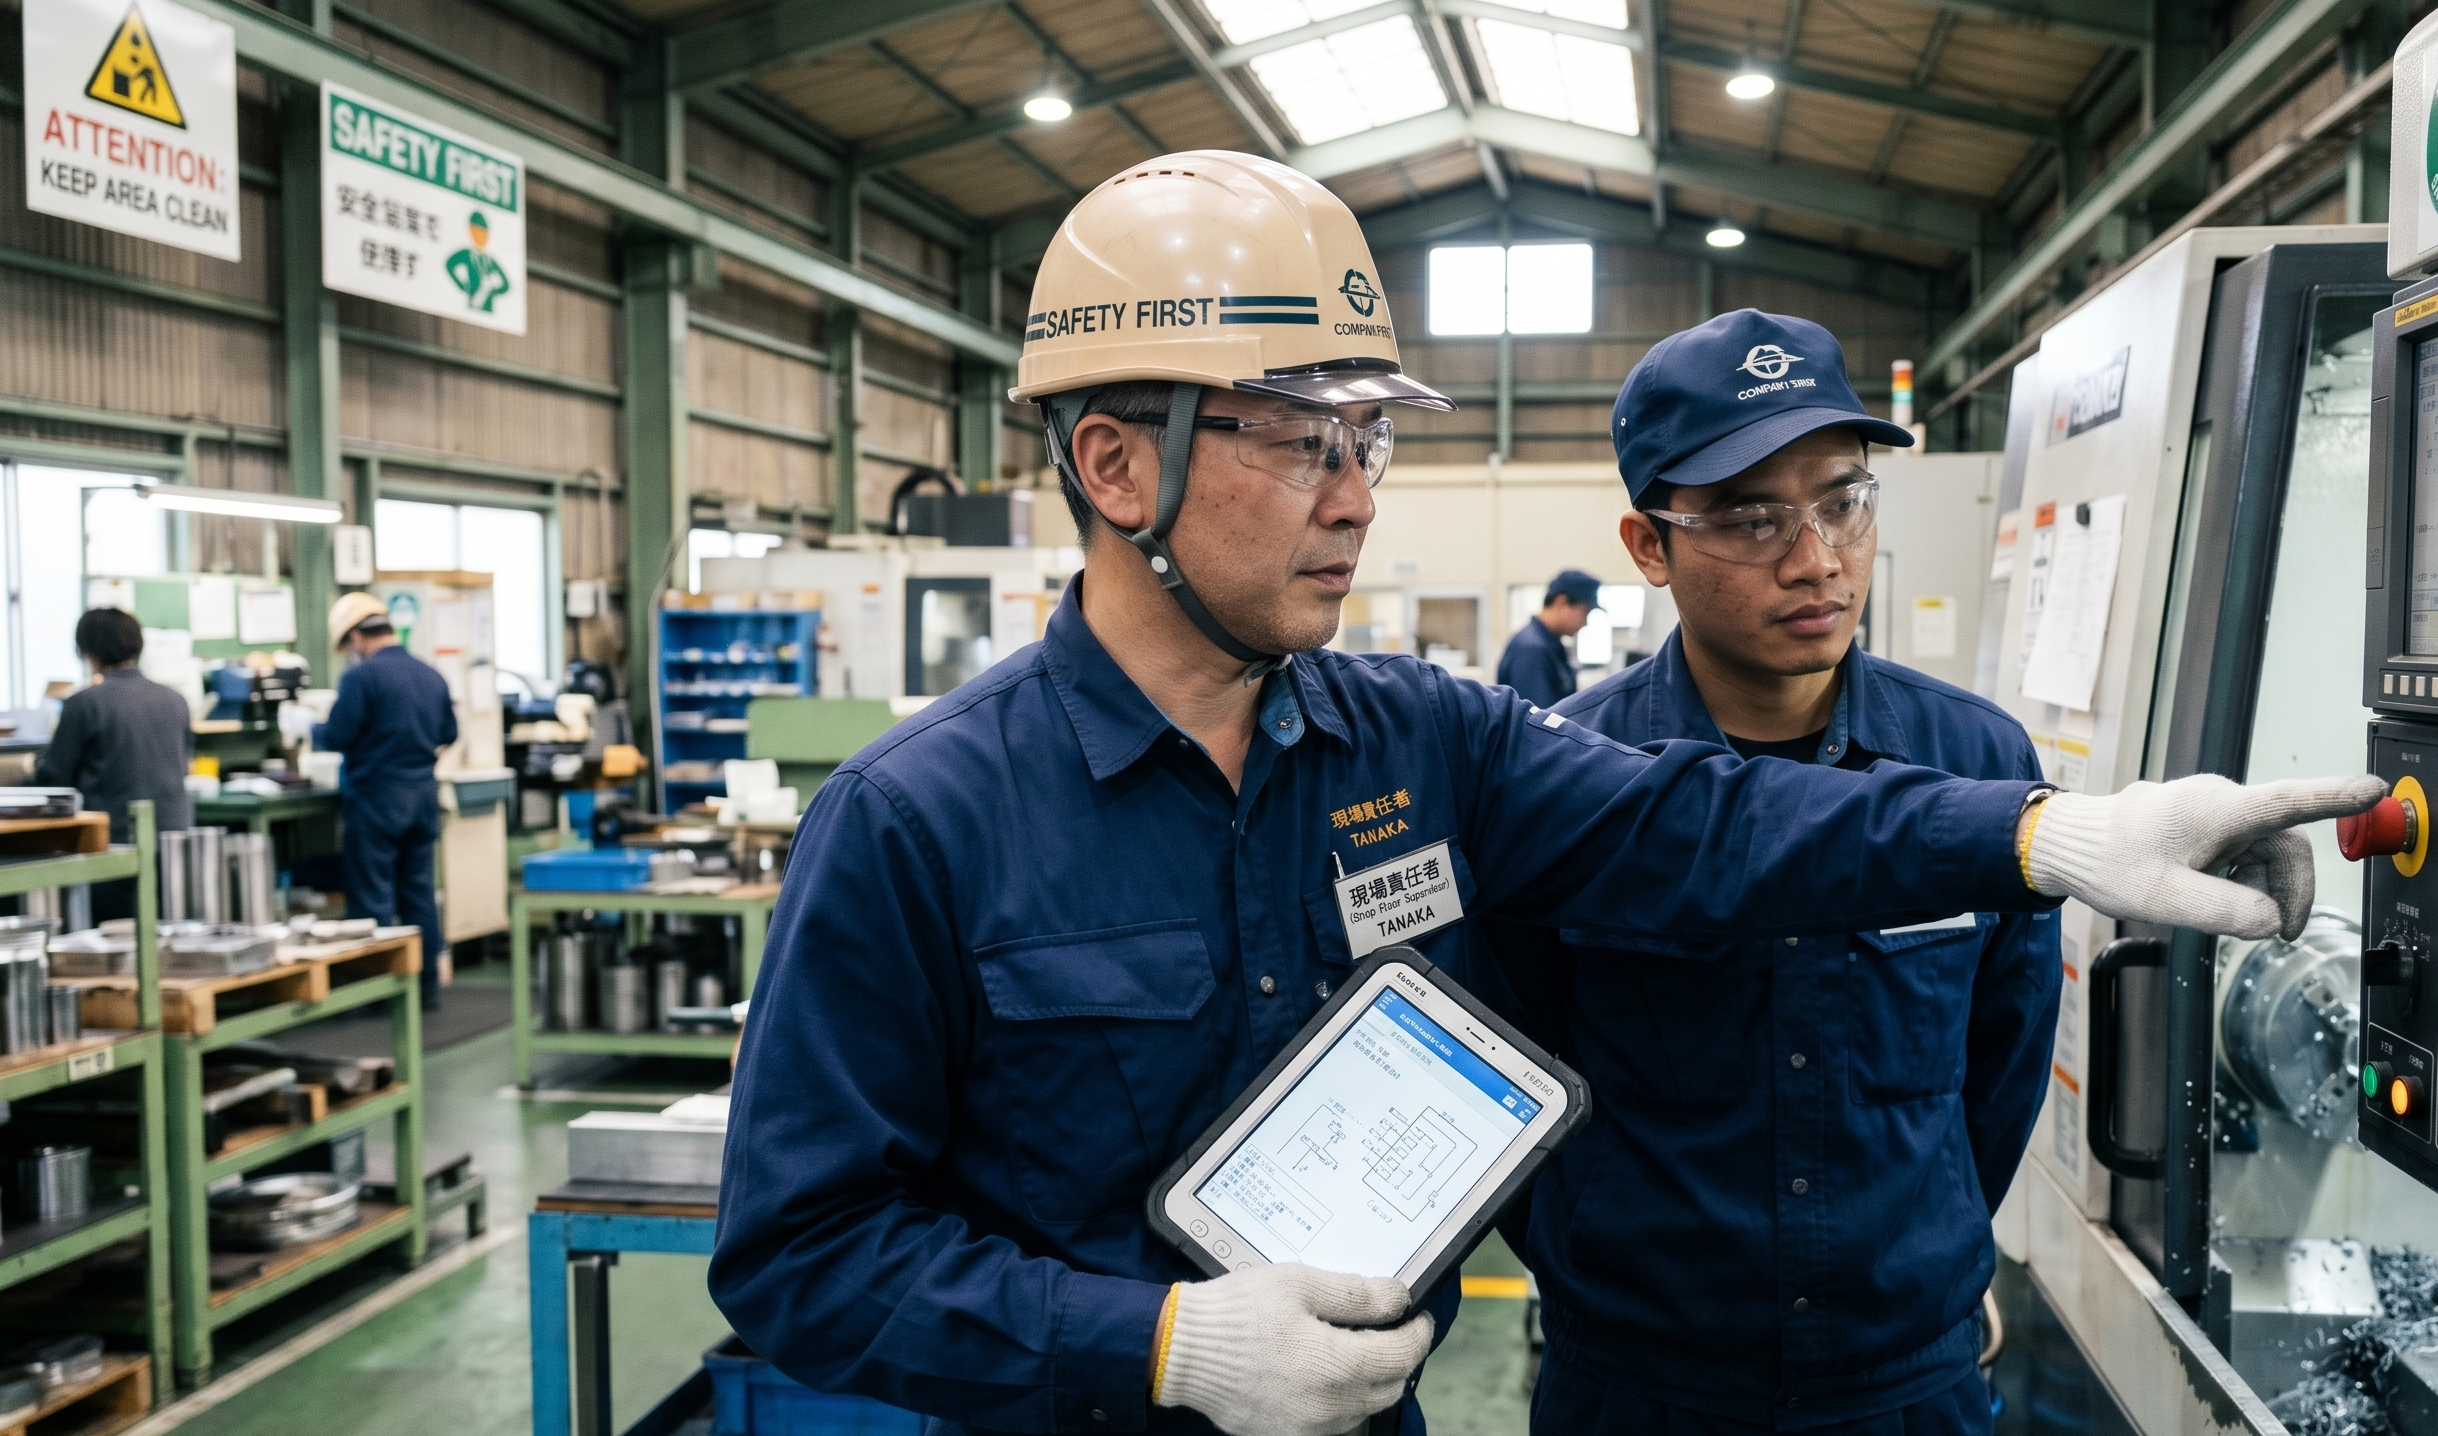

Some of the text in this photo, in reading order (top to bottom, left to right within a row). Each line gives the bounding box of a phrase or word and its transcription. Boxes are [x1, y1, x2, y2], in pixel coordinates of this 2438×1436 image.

[43, 108, 226, 192] ATTENTION:
[334, 102, 515, 208] SAFETY FIRST
[41, 158, 228, 233] KEEP AREA CLEAN
[1046, 297, 1214, 339] SAFETY FIRST
[1349, 818, 1409, 848] TANAKA
[1377, 904, 1436, 937] TANAKA
